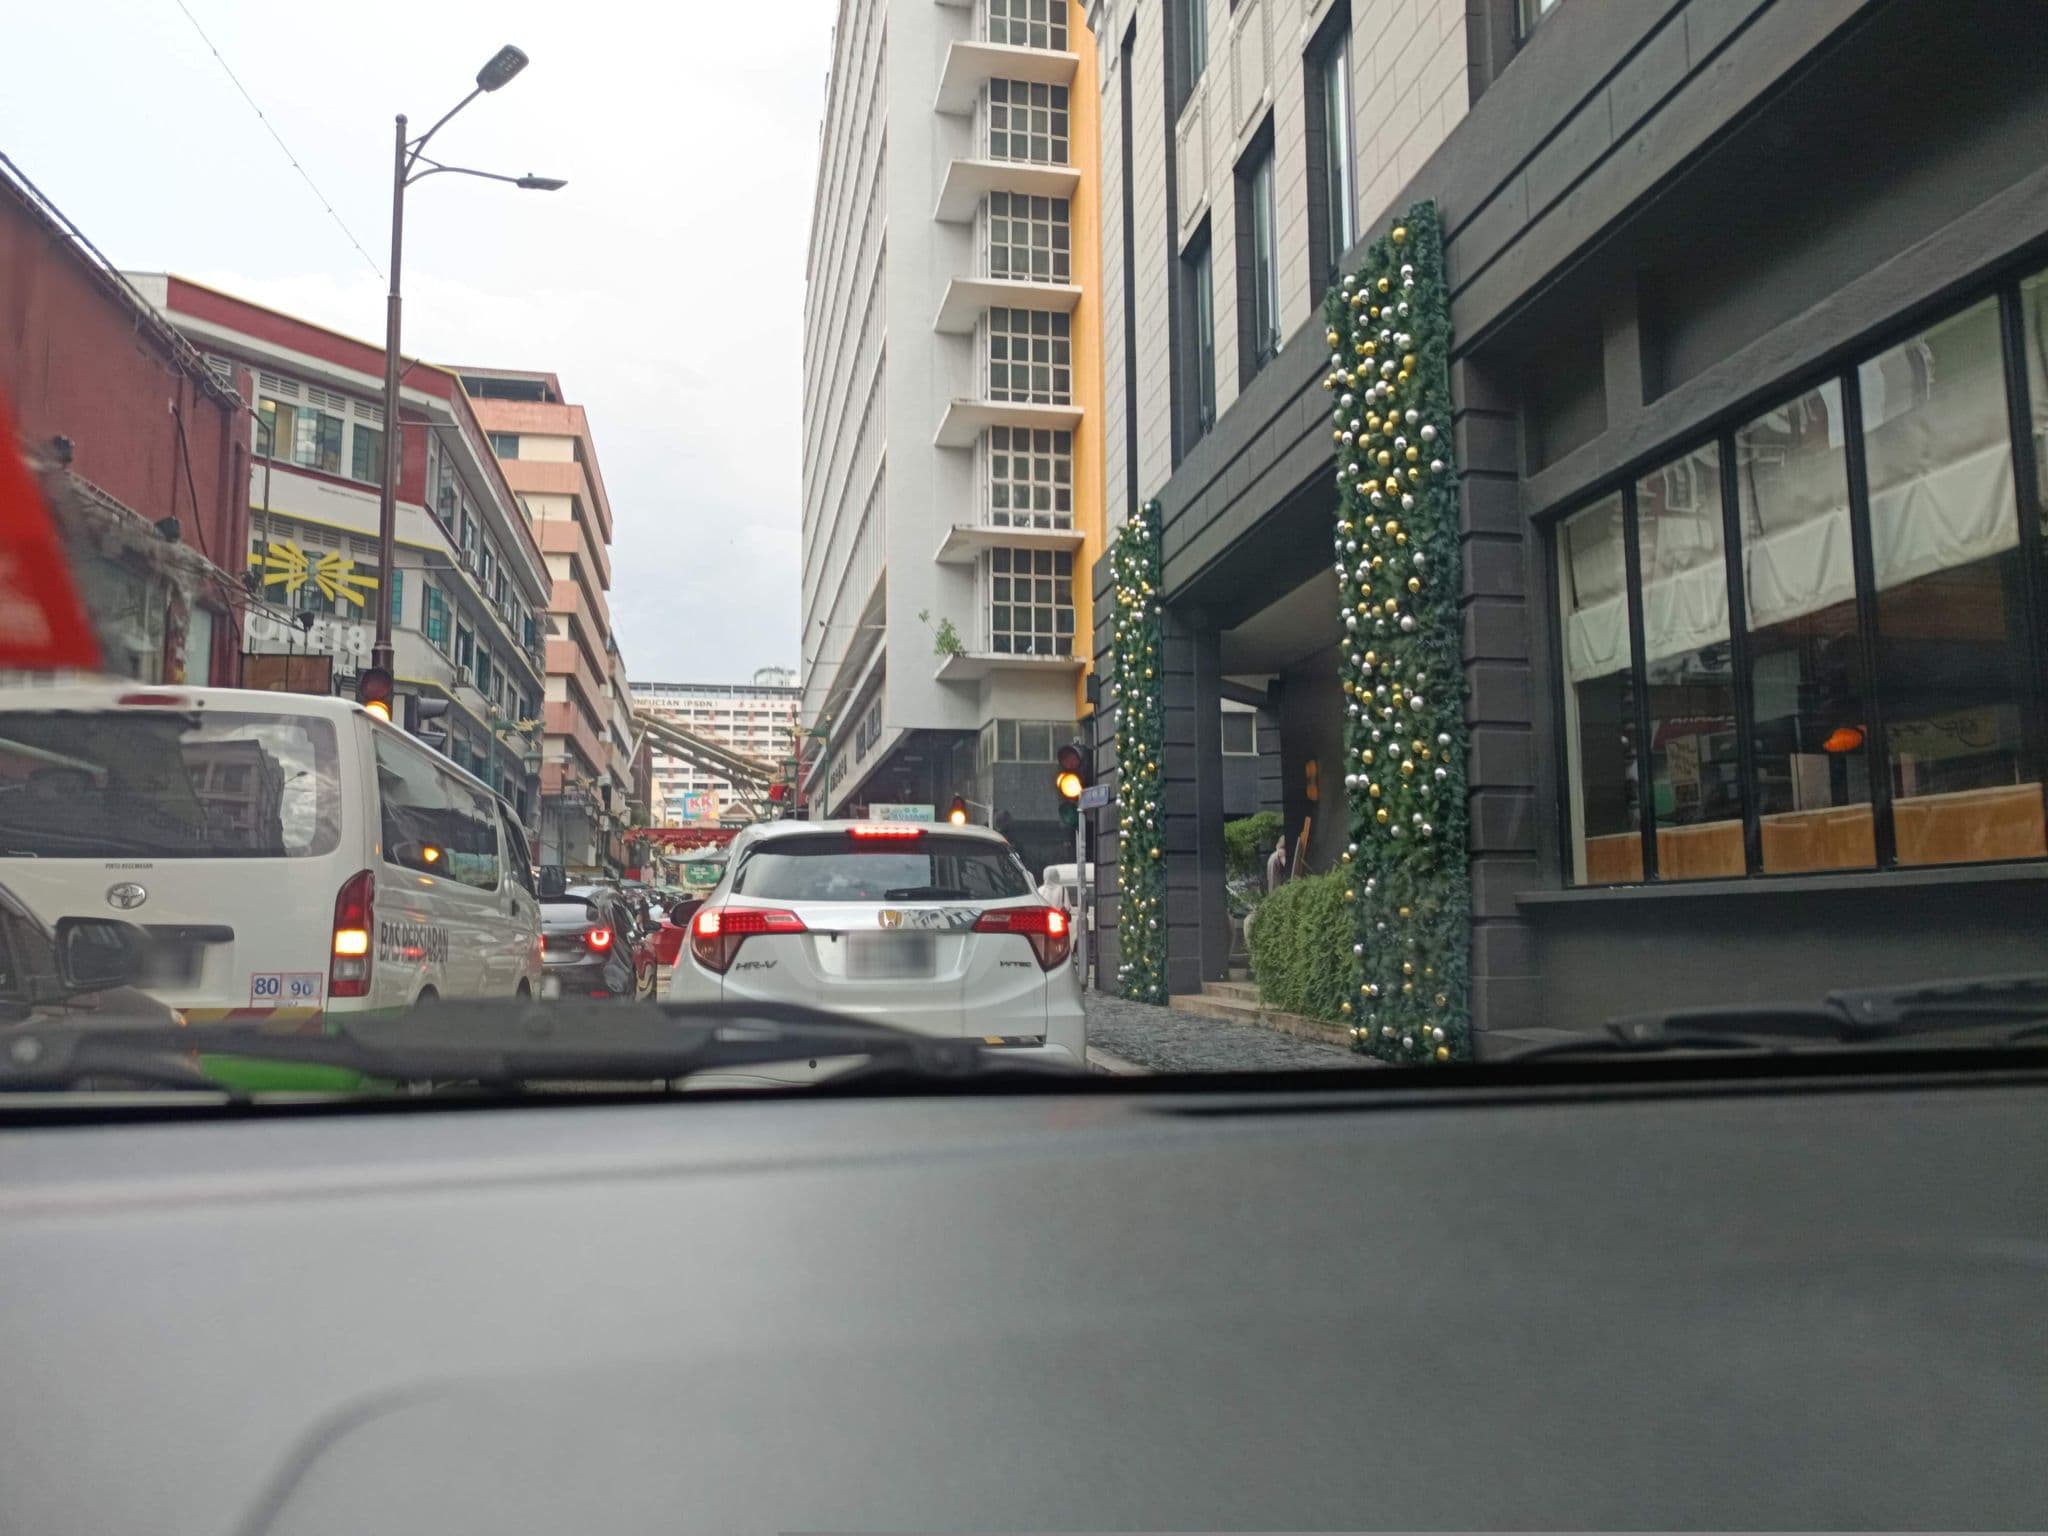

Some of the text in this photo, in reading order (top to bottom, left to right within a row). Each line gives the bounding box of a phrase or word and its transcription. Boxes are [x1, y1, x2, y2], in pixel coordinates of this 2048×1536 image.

[632, 698, 680, 707] ONFUCIAN
[736, 960, 778, 970] HR-V
[254, 977, 313, 996] 80 90
